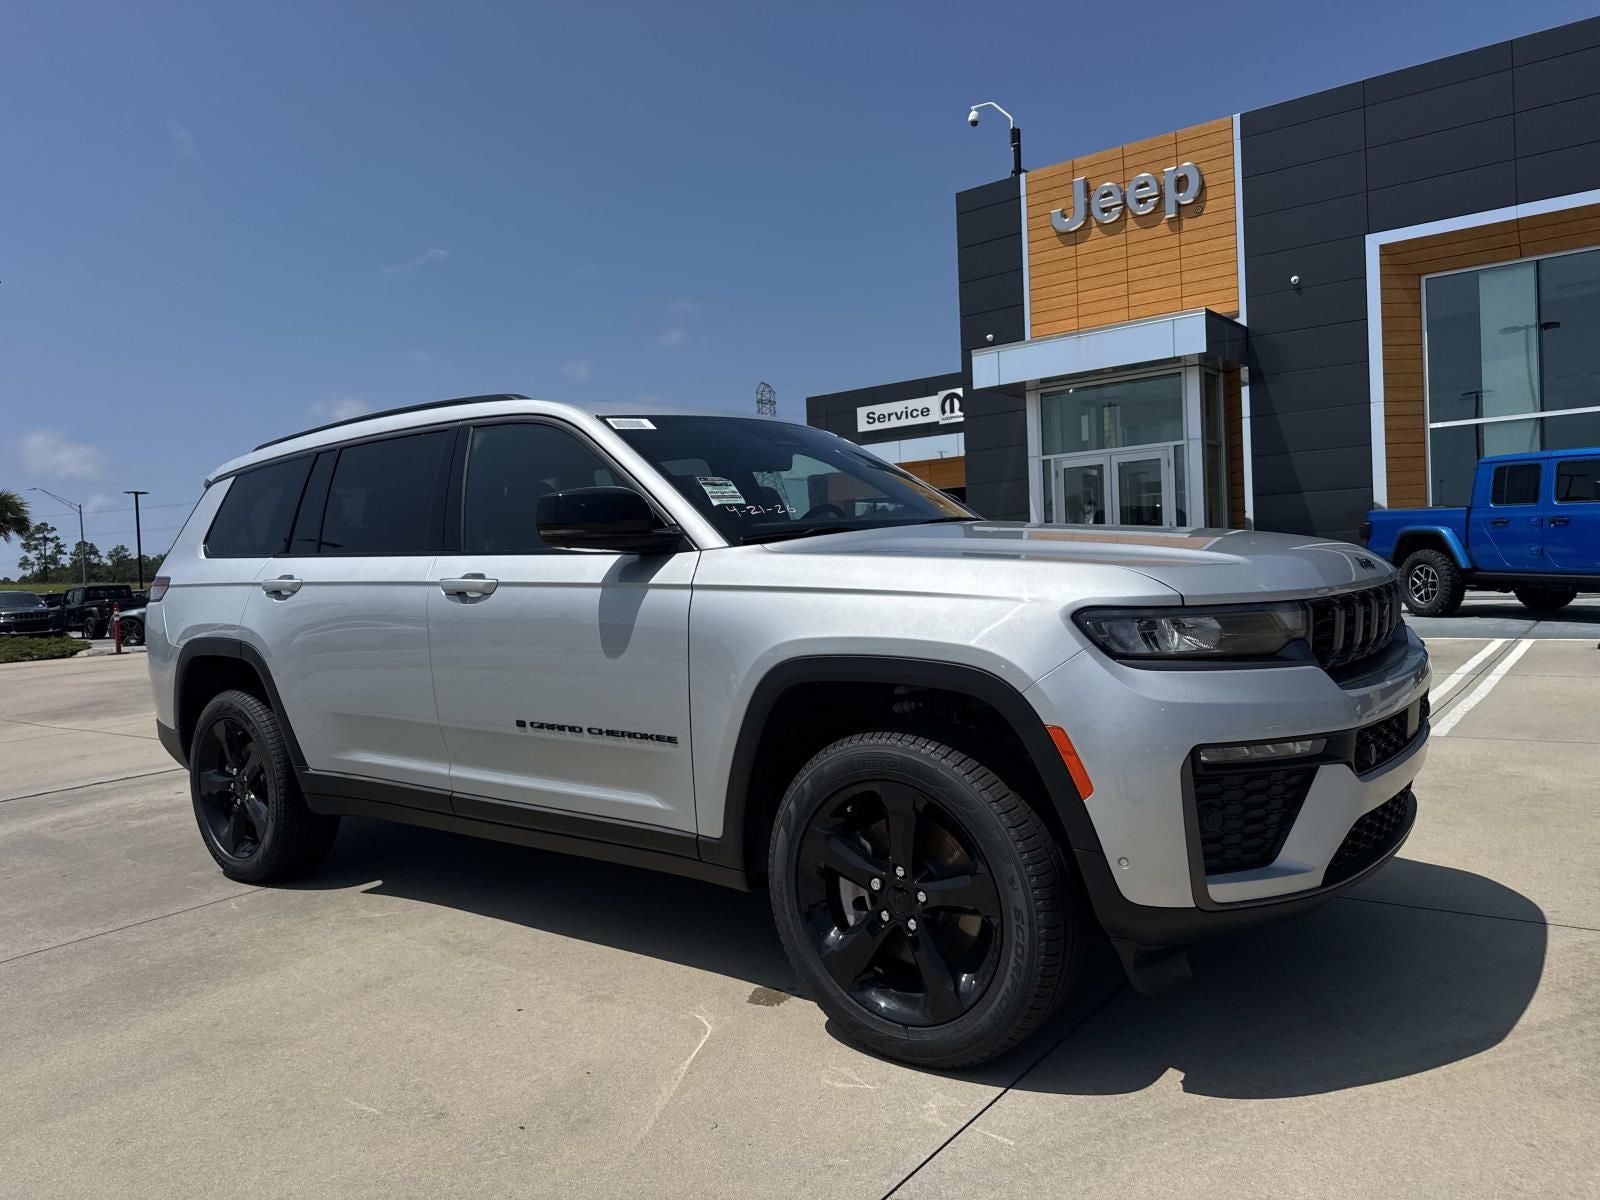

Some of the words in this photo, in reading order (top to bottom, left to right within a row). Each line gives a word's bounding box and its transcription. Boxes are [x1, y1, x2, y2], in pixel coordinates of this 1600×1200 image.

[1050, 162, 1202, 233] Jeep
[866, 406, 931, 425] Service
[726, 504, 796, 517] 4-21-26
[529, 721, 583, 734] GRAND
[587, 726, 679, 744] CHEROKEE
